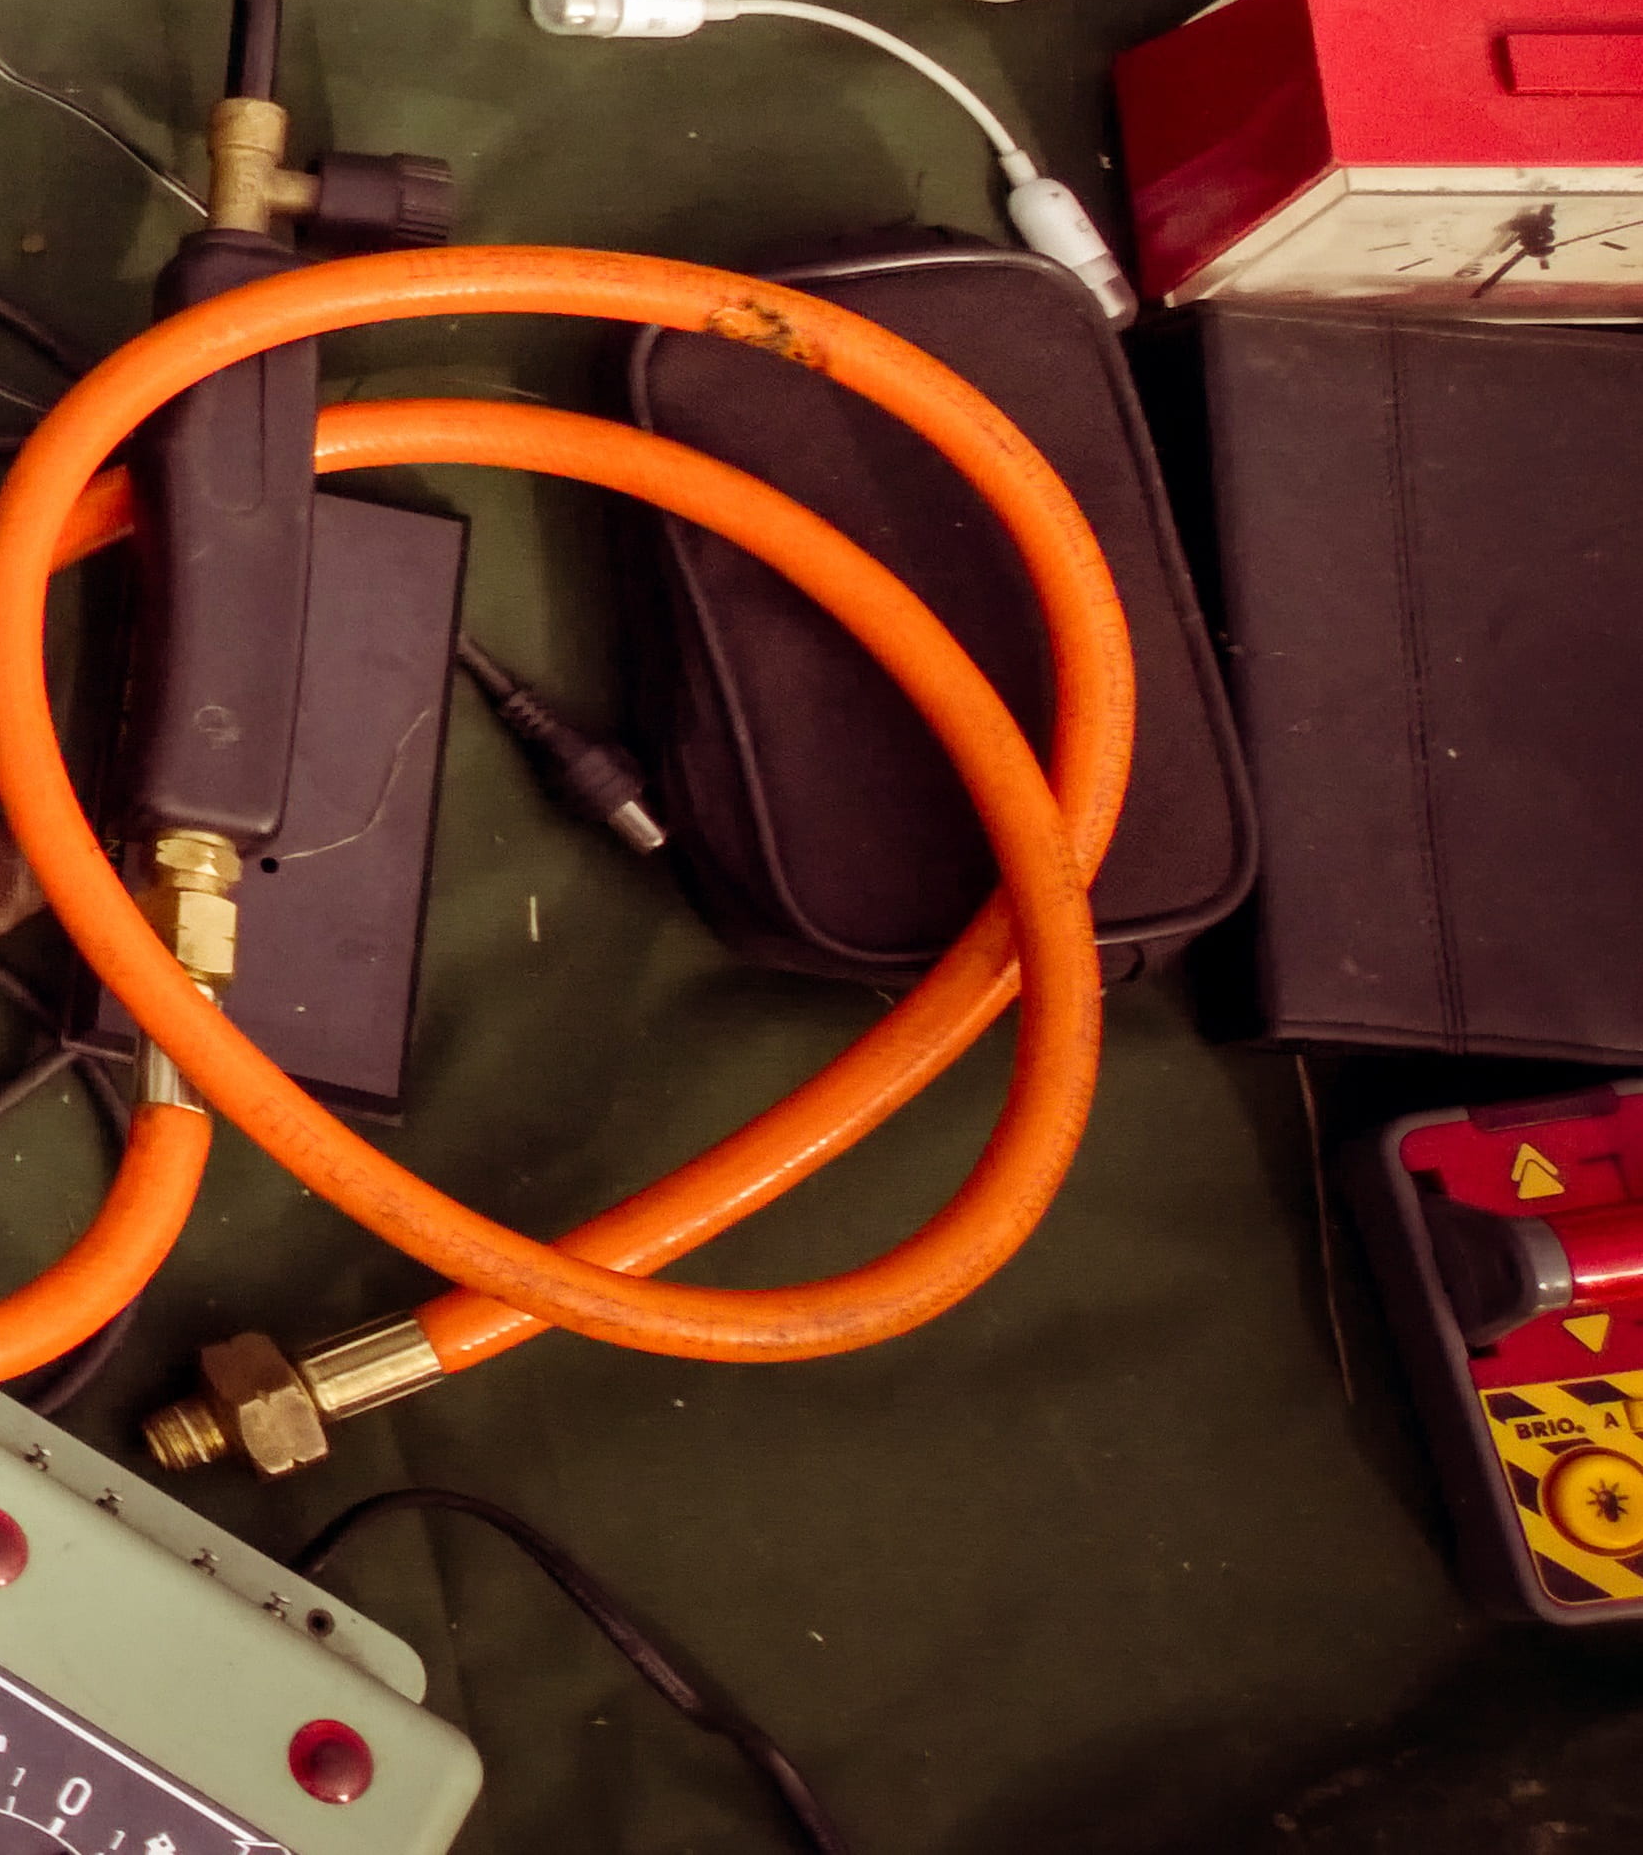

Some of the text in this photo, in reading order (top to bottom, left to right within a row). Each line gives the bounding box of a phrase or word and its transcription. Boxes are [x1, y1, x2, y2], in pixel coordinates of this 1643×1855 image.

[1603, 1411, 1620, 1429] A
[10, 1767, 26, 1788] 1
[55, 1776, 93, 1817] 0
[108, 1829, 125, 1851] 1
